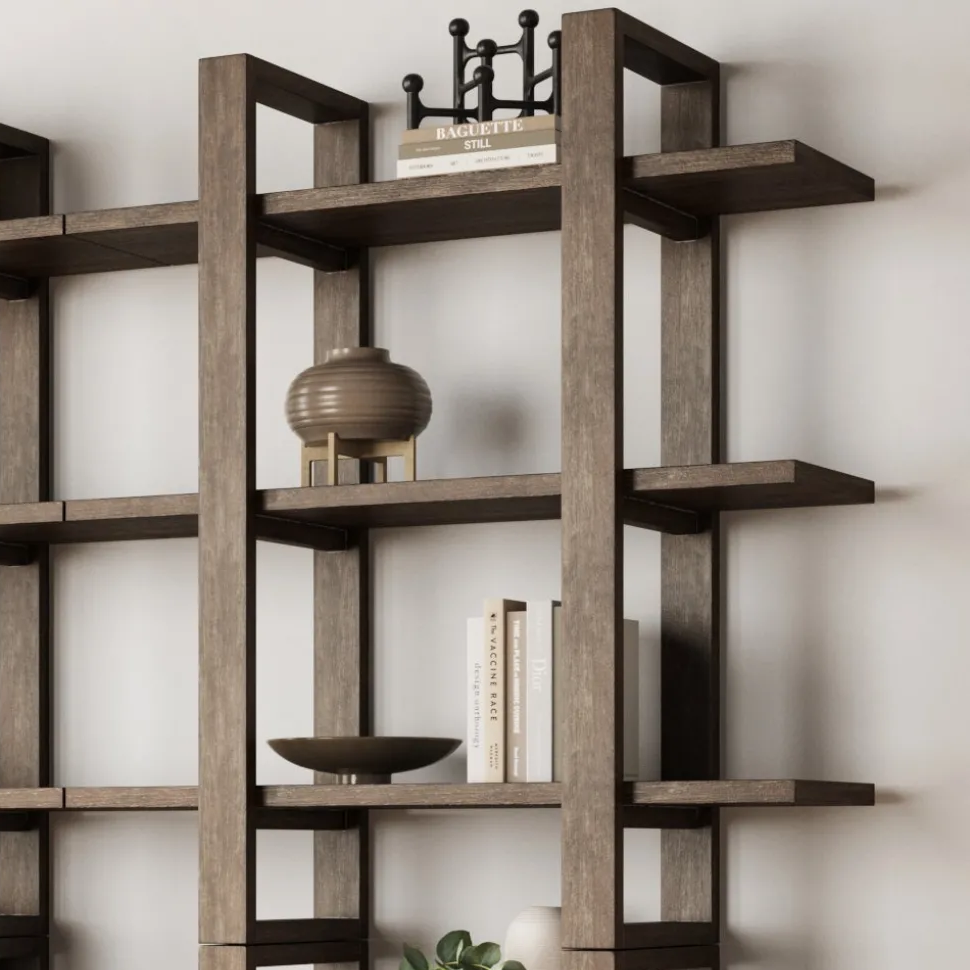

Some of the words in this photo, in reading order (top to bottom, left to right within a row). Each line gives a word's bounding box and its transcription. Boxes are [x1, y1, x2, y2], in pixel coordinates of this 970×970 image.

[436, 119, 524, 140] BAGUETTE
[463, 139, 492, 150] STILL
[489, 638, 498, 686] VACCINE
[531, 658, 547, 692] Dior
[489, 693, 498, 721] RACE
